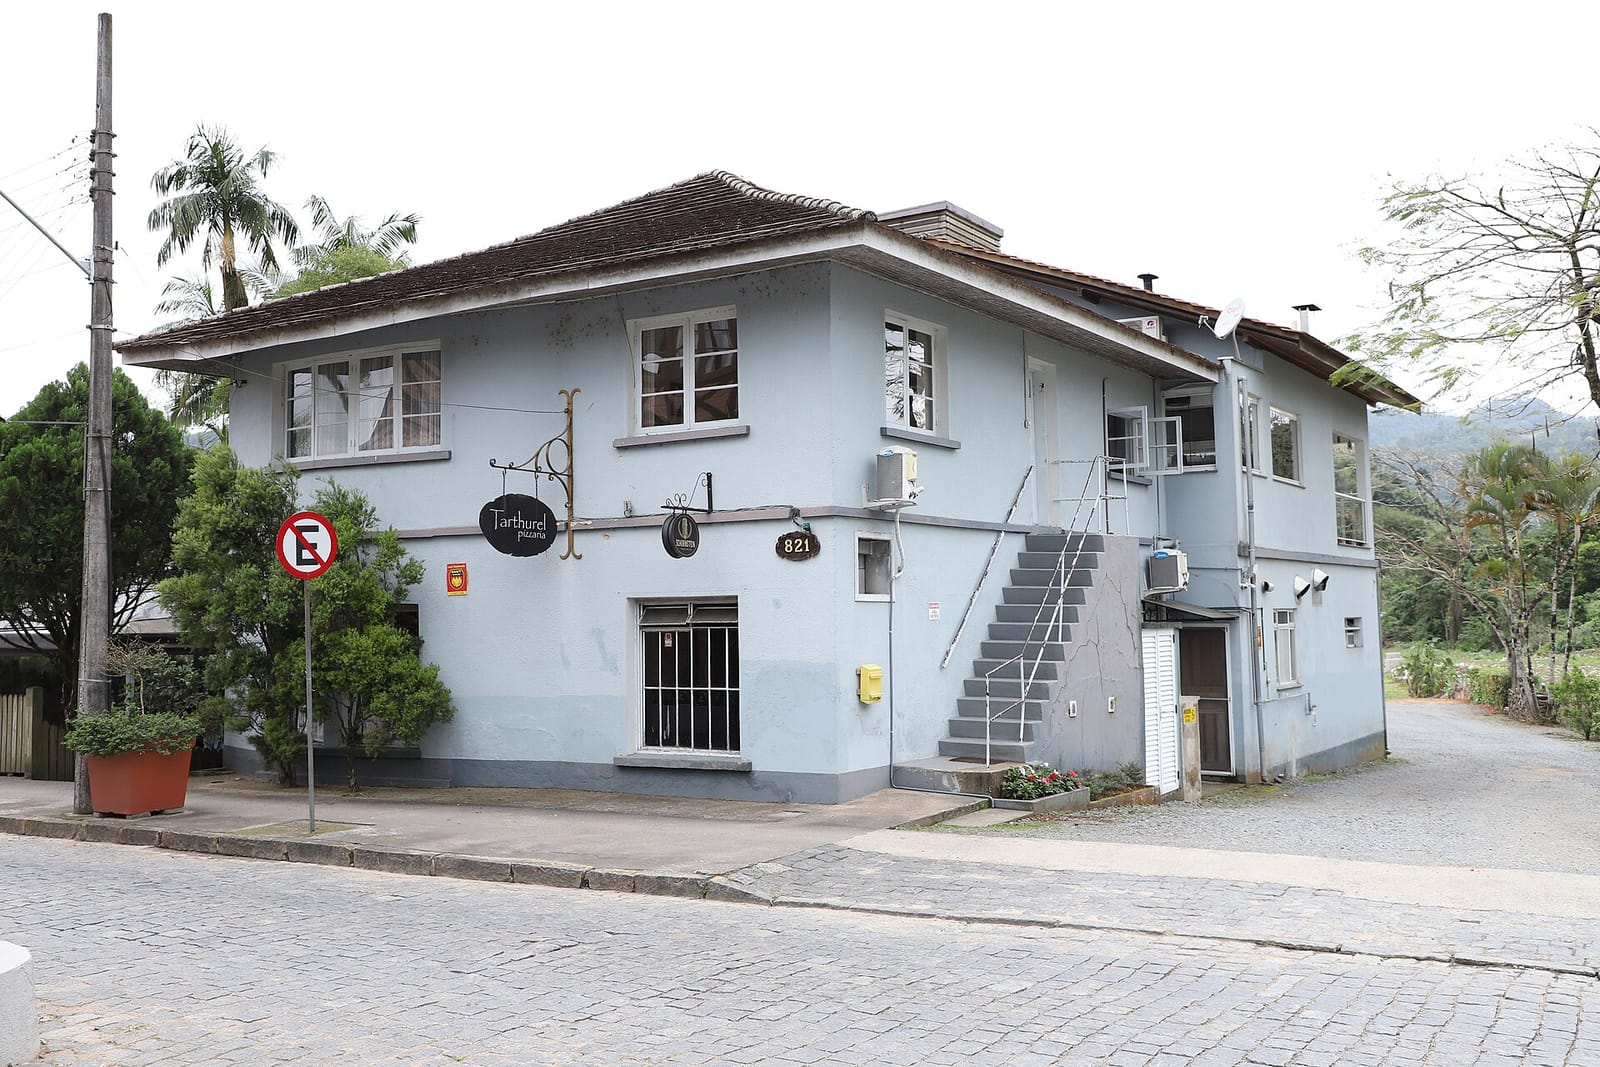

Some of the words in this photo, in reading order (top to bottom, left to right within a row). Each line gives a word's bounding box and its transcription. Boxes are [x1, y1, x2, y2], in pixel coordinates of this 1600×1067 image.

[489, 508, 546, 531] Tarthurel
[295, 525, 319, 566] E
[517, 530, 546, 542] pizzaria
[784, 538, 810, 553] 821
